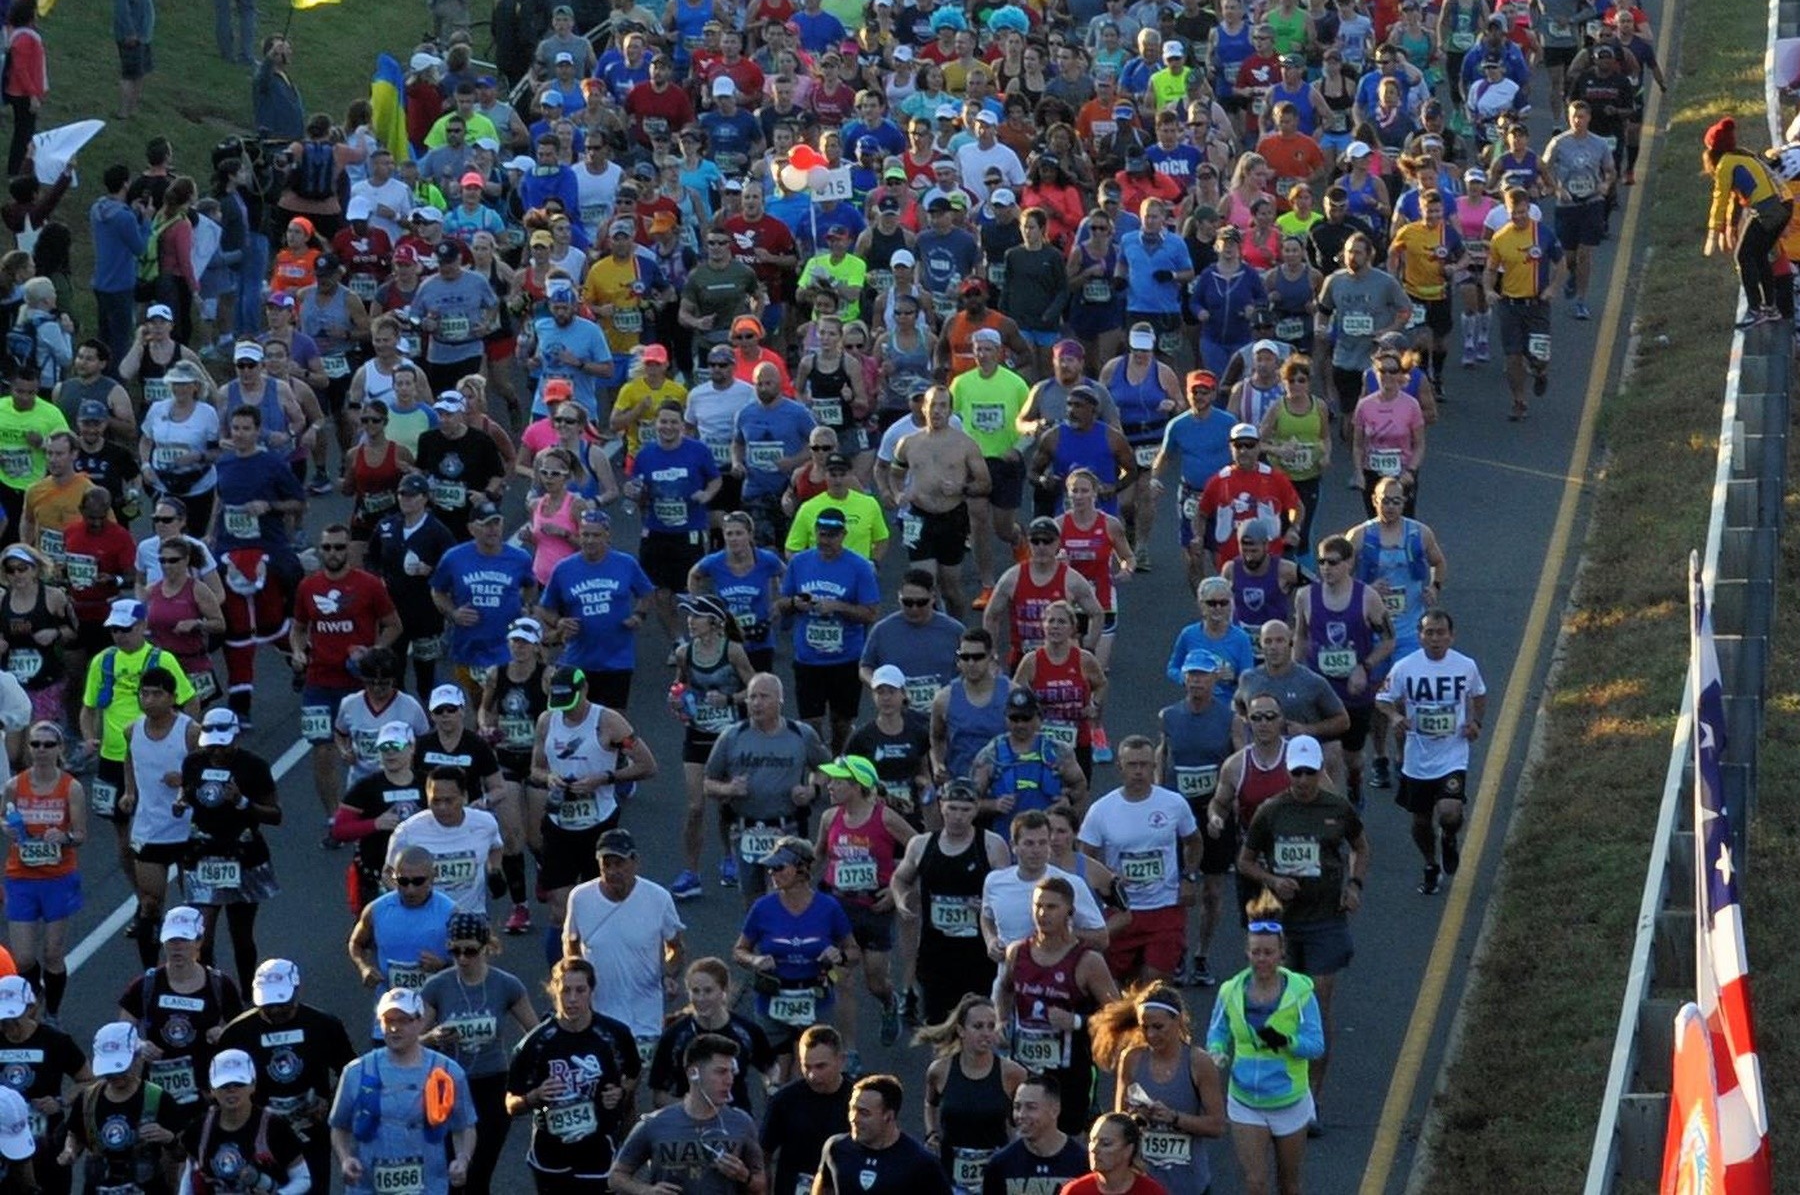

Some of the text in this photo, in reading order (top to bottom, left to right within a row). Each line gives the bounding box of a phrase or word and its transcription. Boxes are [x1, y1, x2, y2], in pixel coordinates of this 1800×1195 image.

[471, 584, 503, 596] TRACK
[580, 591, 613, 605] TRACK
[472, 596, 501, 608] CLUB
[583, 603, 610, 617] CLUB
[1406, 675, 1467, 703] IAFF
[940, 908, 969, 924] 7531
[550, 1108, 593, 1129] 19354
[1144, 1137, 1187, 1155] 15977
[375, 1168, 420, 1190] 16566
